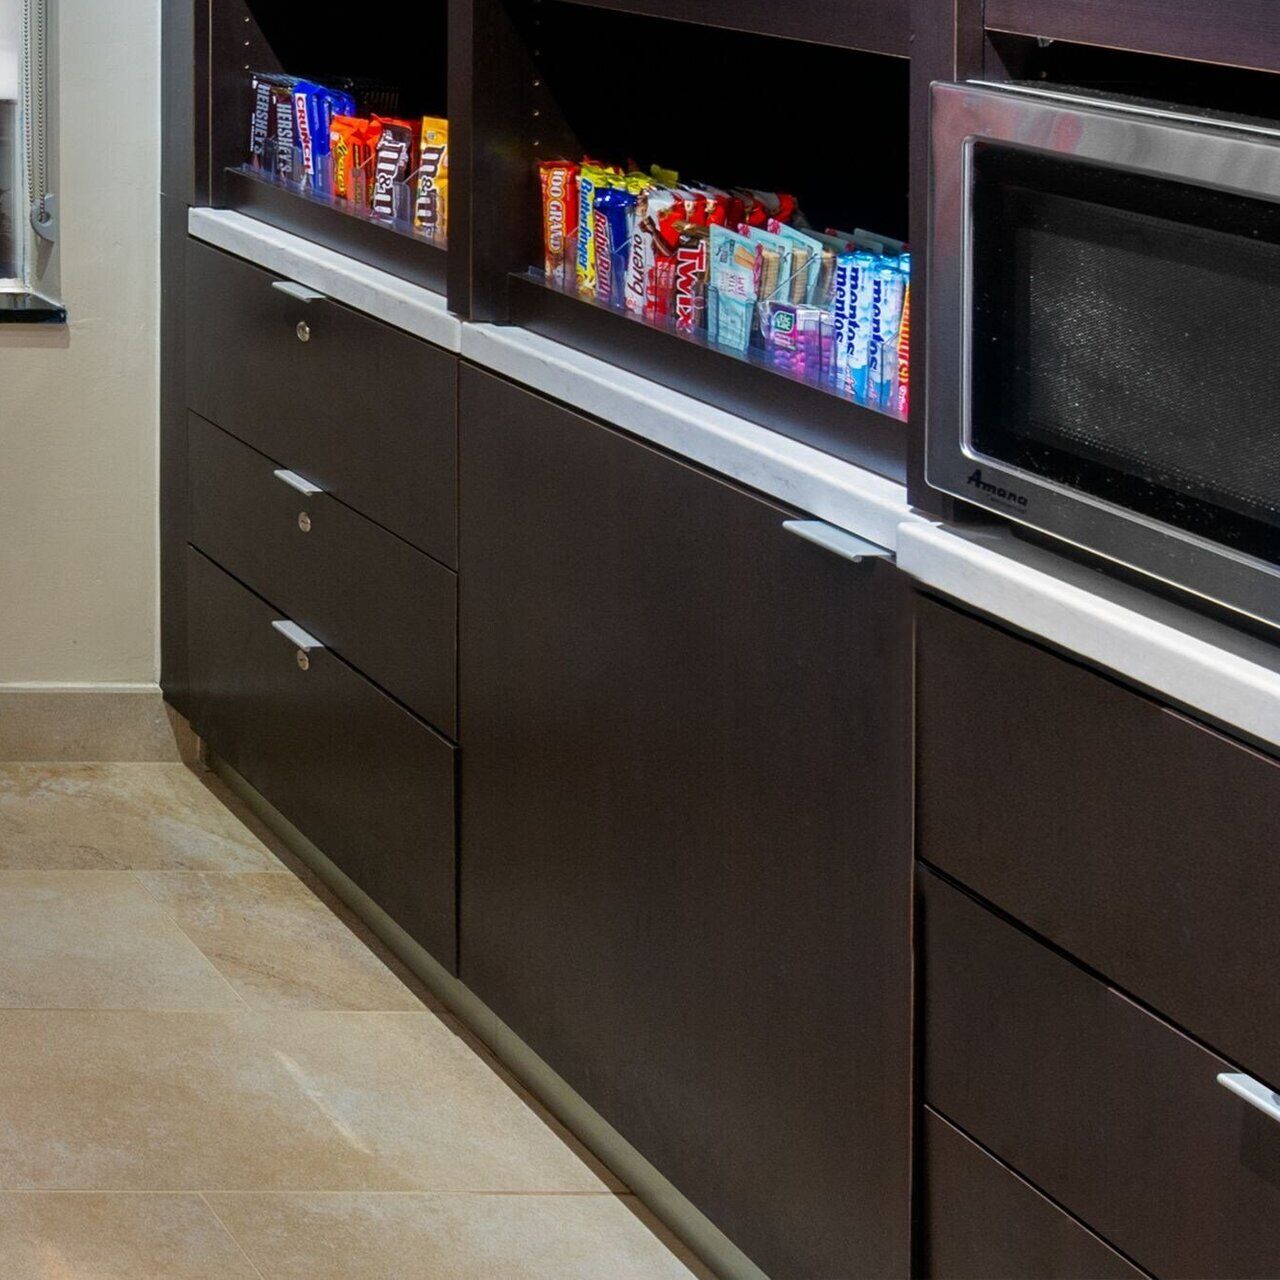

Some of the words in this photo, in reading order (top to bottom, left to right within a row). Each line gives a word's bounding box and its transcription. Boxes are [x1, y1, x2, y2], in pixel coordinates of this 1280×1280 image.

[254, 82, 271, 156] HERSHEY'S
[276, 103, 293, 174] HERSHEY'S
[297, 95, 312, 170] CRUNCH
[549, 169, 565, 198] 100
[549, 200, 565, 253] GRAND
[578, 178, 594, 270] Butterfinger
[594, 211, 608, 249] Baby
[597, 251, 611, 299] Ruth
[628, 233, 643, 296] bueno
[676, 240, 707, 333] TWIX
[834, 266, 849, 343] mentos
[847, 267, 860, 356] mentos
[869, 279, 884, 371] mentos
[967, 468, 1028, 507] Amana
